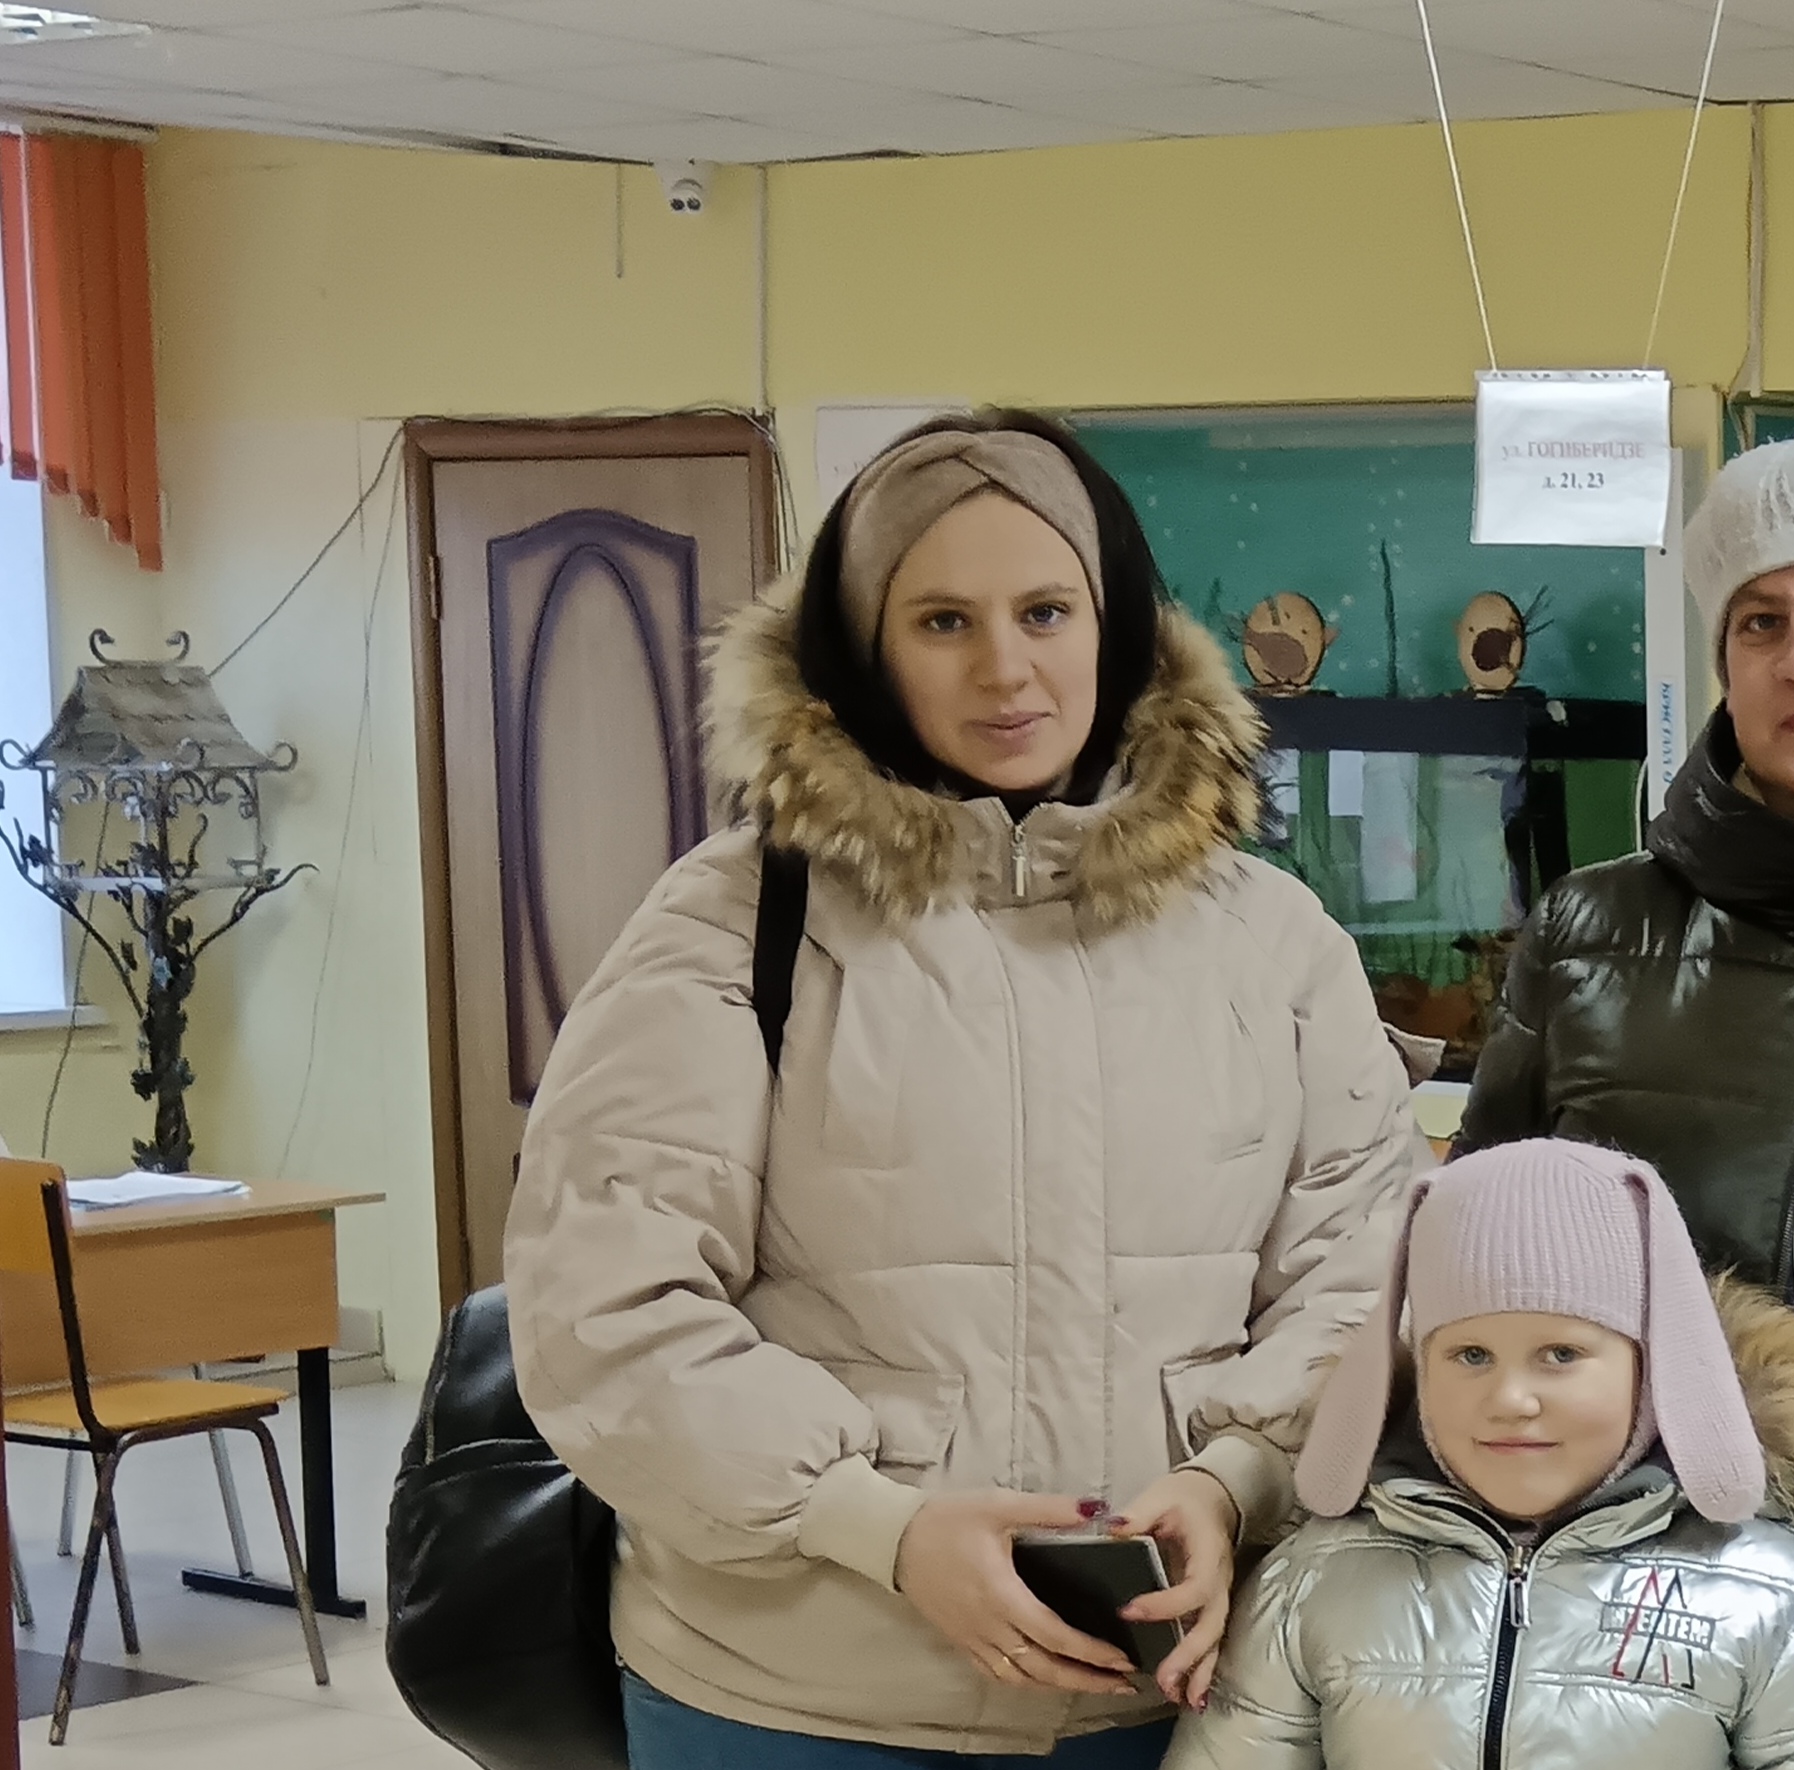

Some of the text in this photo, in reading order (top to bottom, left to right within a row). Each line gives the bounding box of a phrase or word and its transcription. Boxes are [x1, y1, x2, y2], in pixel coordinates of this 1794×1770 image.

[1528, 441, 1645, 459] ГОГИБЕРИДЗЕ
[1560, 472, 1582, 489] 21,
[1587, 472, 1604, 488] 23
